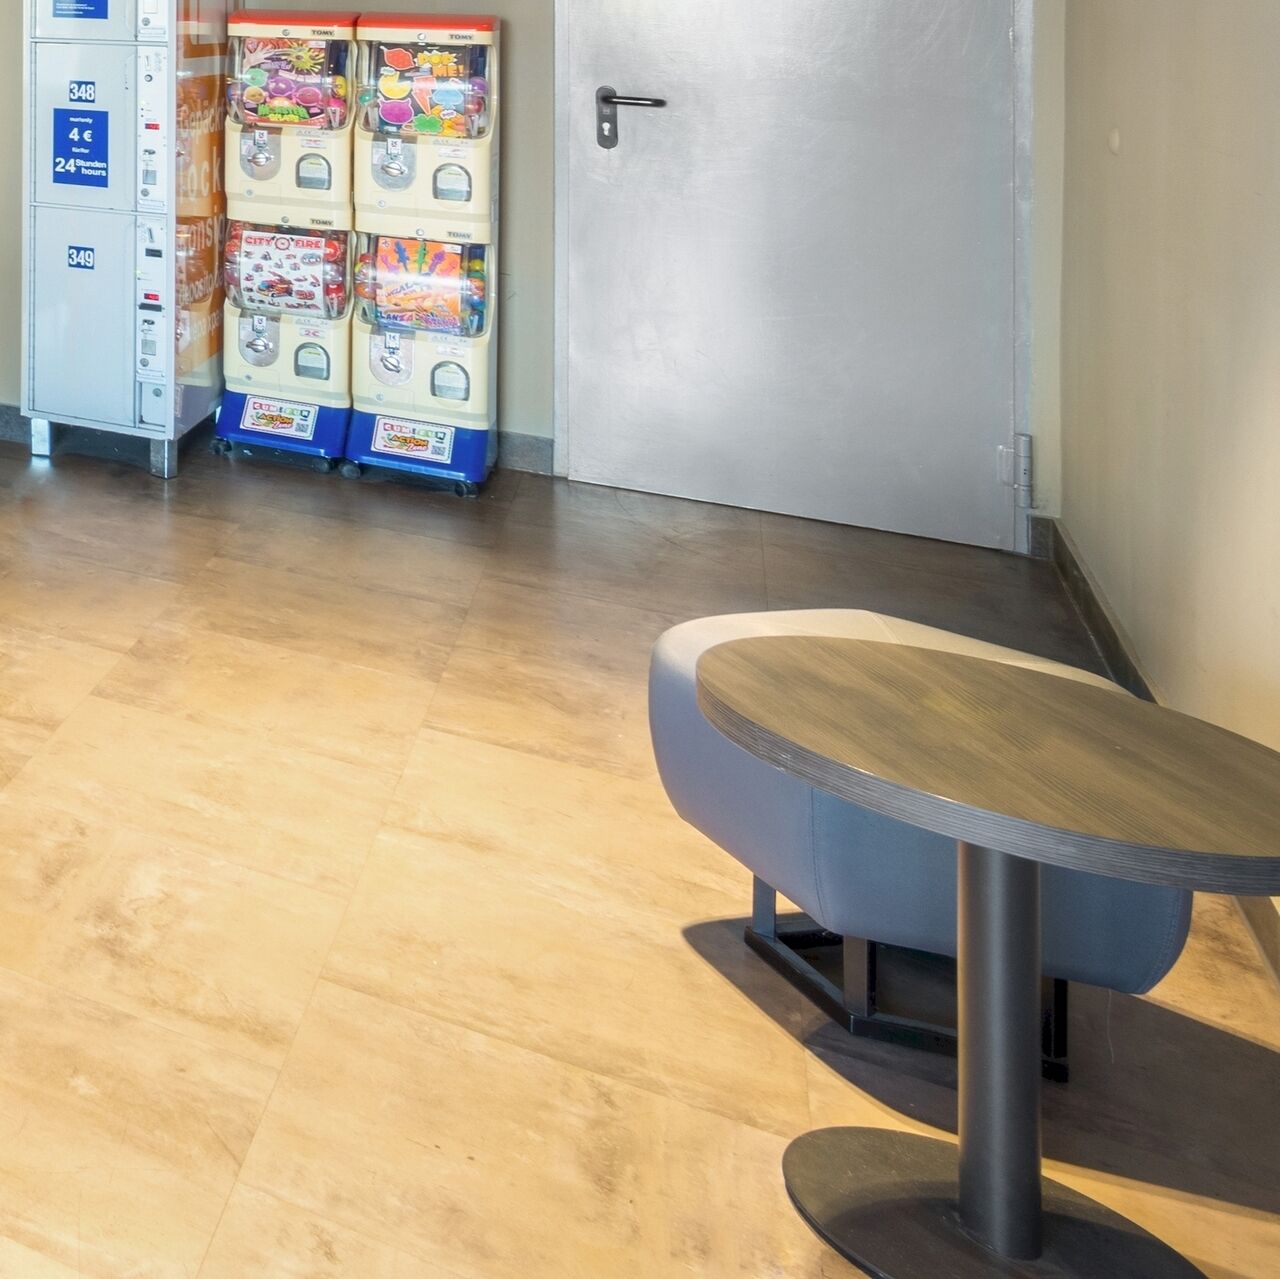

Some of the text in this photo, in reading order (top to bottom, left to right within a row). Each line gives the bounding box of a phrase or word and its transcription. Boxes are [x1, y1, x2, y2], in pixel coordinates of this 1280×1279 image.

[312, 29, 335, 37] TOMY
[70, 83, 95, 101] 348
[68, 127, 93, 142] 4 €
[55, 157, 107, 173] 24 Stunden
[81, 167, 107, 176] hours
[310, 218, 334, 226] TOMY
[447, 231, 472, 239] TOMY
[245, 236, 322, 249] CITY FIRE
[69, 248, 94, 267] 349
[259, 413, 294, 425] ACTION
[390, 434, 429, 447] ACTION
